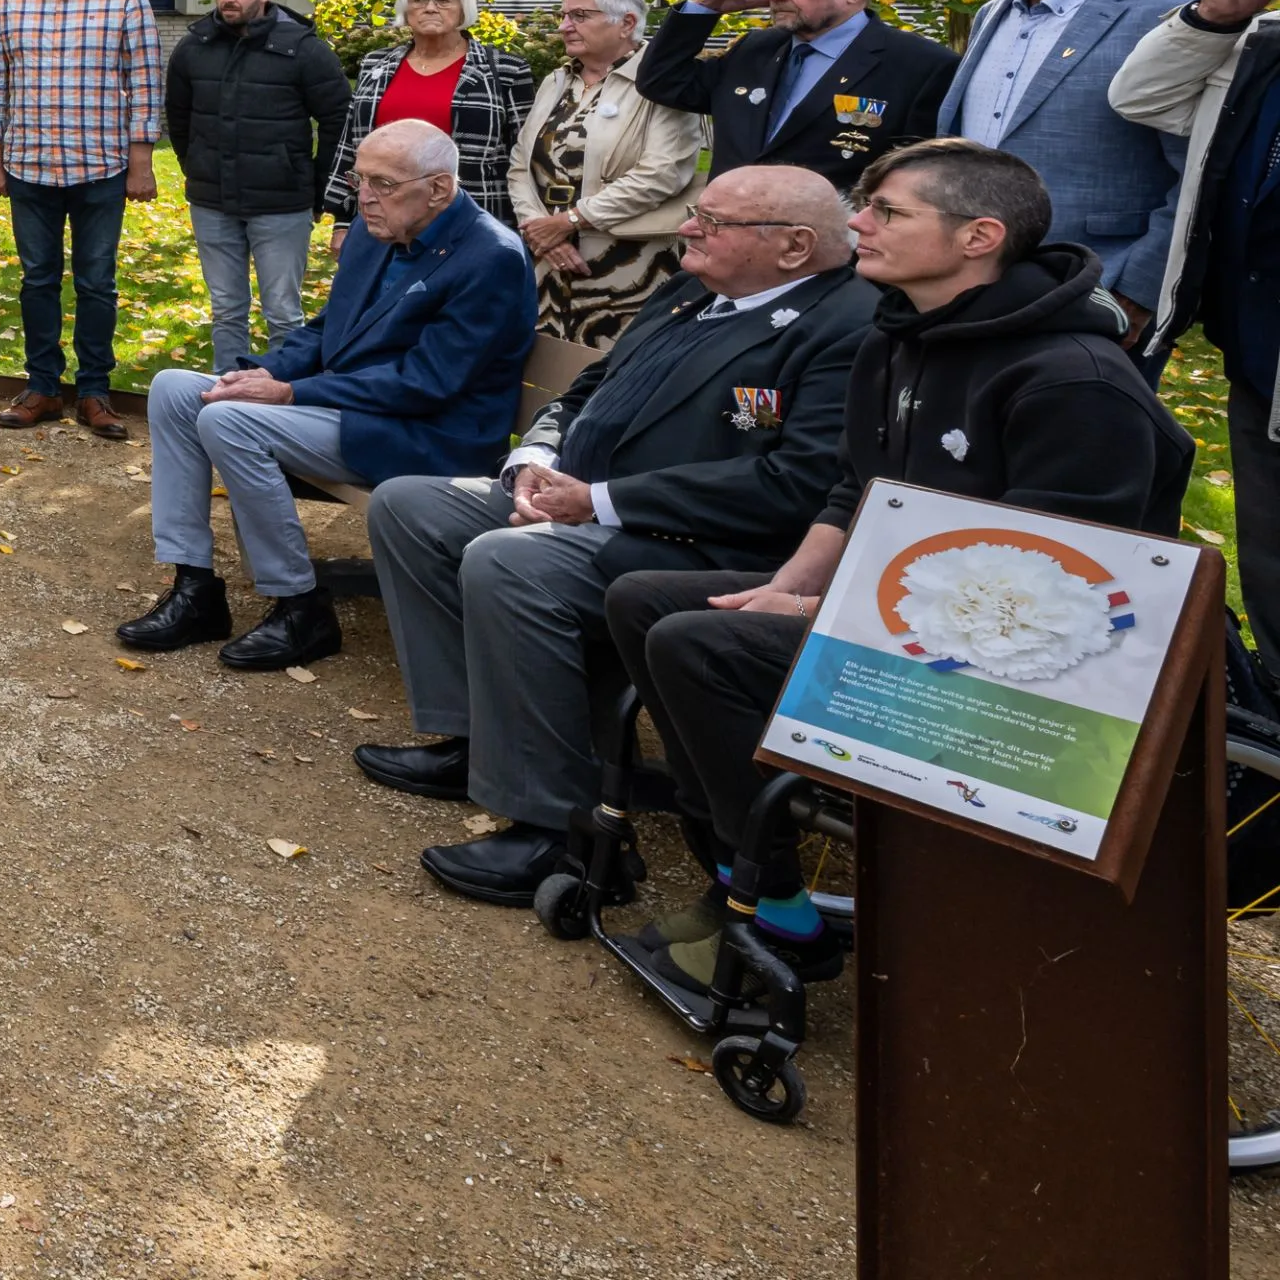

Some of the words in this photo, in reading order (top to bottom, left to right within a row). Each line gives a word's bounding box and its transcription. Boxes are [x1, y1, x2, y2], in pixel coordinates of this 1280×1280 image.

[839, 675, 895, 697] Nederlandse
[842, 667, 857, 678] het
[858, 674, 897, 689] symbool
[899, 686, 916, 695] van
[917, 691, 964, 710] erkenning
[980, 710, 1036, 731] waardering
[1038, 727, 1061, 737] voor
[859, 665, 877, 674] jaar
[906, 679, 925, 688] hier
[940, 689, 965, 700] witte
[1011, 710, 1037, 721] witte
[1038, 718, 1066, 729] anjer
[833, 691, 879, 710] Gemeente
[977, 735, 1005, 748] heeft
[1006, 744, 1021, 753] dit
[1022, 750, 1055, 763] perkje
[856, 716, 872, 725] van
[957, 746, 974, 757] het
[891, 718, 927, 734] respect
[942, 734, 967, 745] dank
[968, 742, 991, 753] voor
[992, 748, 1012, 760] hun
[1014, 755, 1039, 768] inzet
